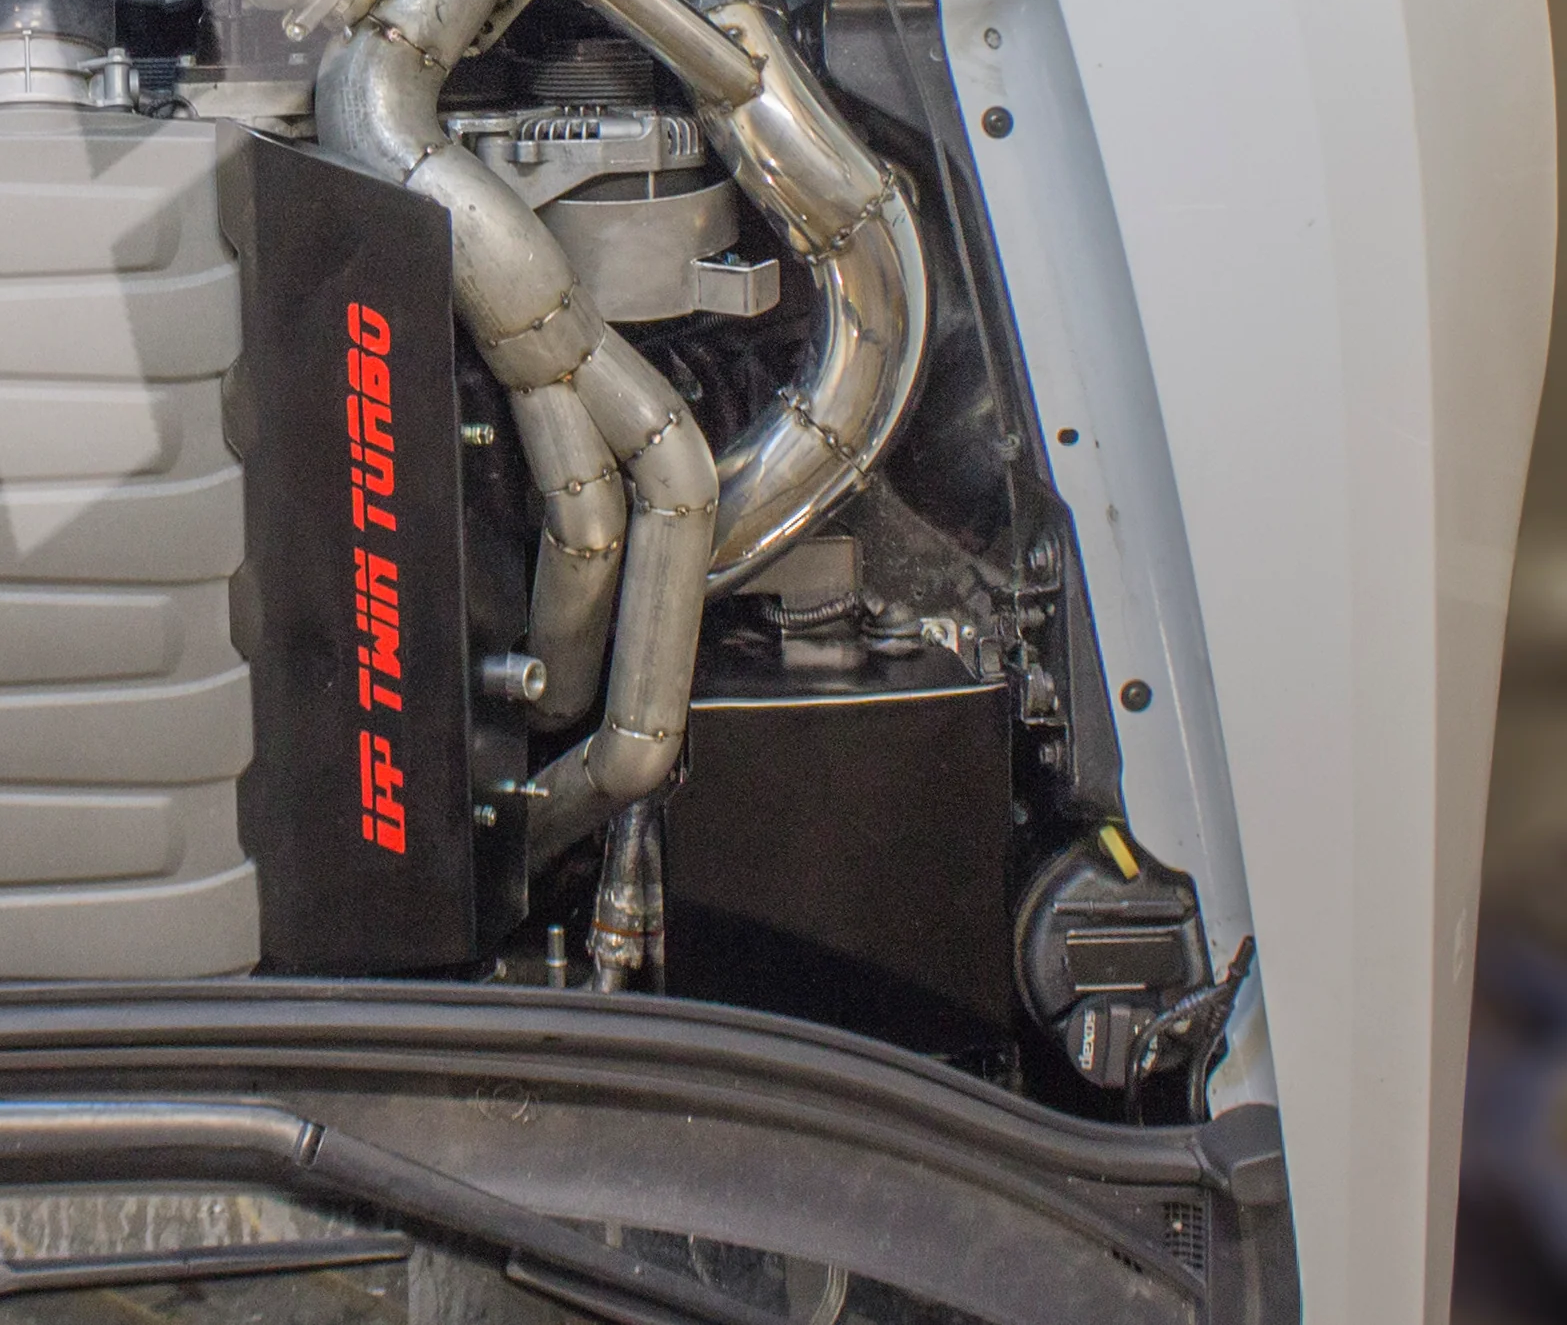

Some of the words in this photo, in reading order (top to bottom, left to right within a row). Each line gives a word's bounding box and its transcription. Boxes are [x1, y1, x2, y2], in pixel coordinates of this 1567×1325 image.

[346, 302, 397, 532] TURBO
[354, 547, 403, 712] TWIN
[1079, 1009, 1096, 1070] dexos
